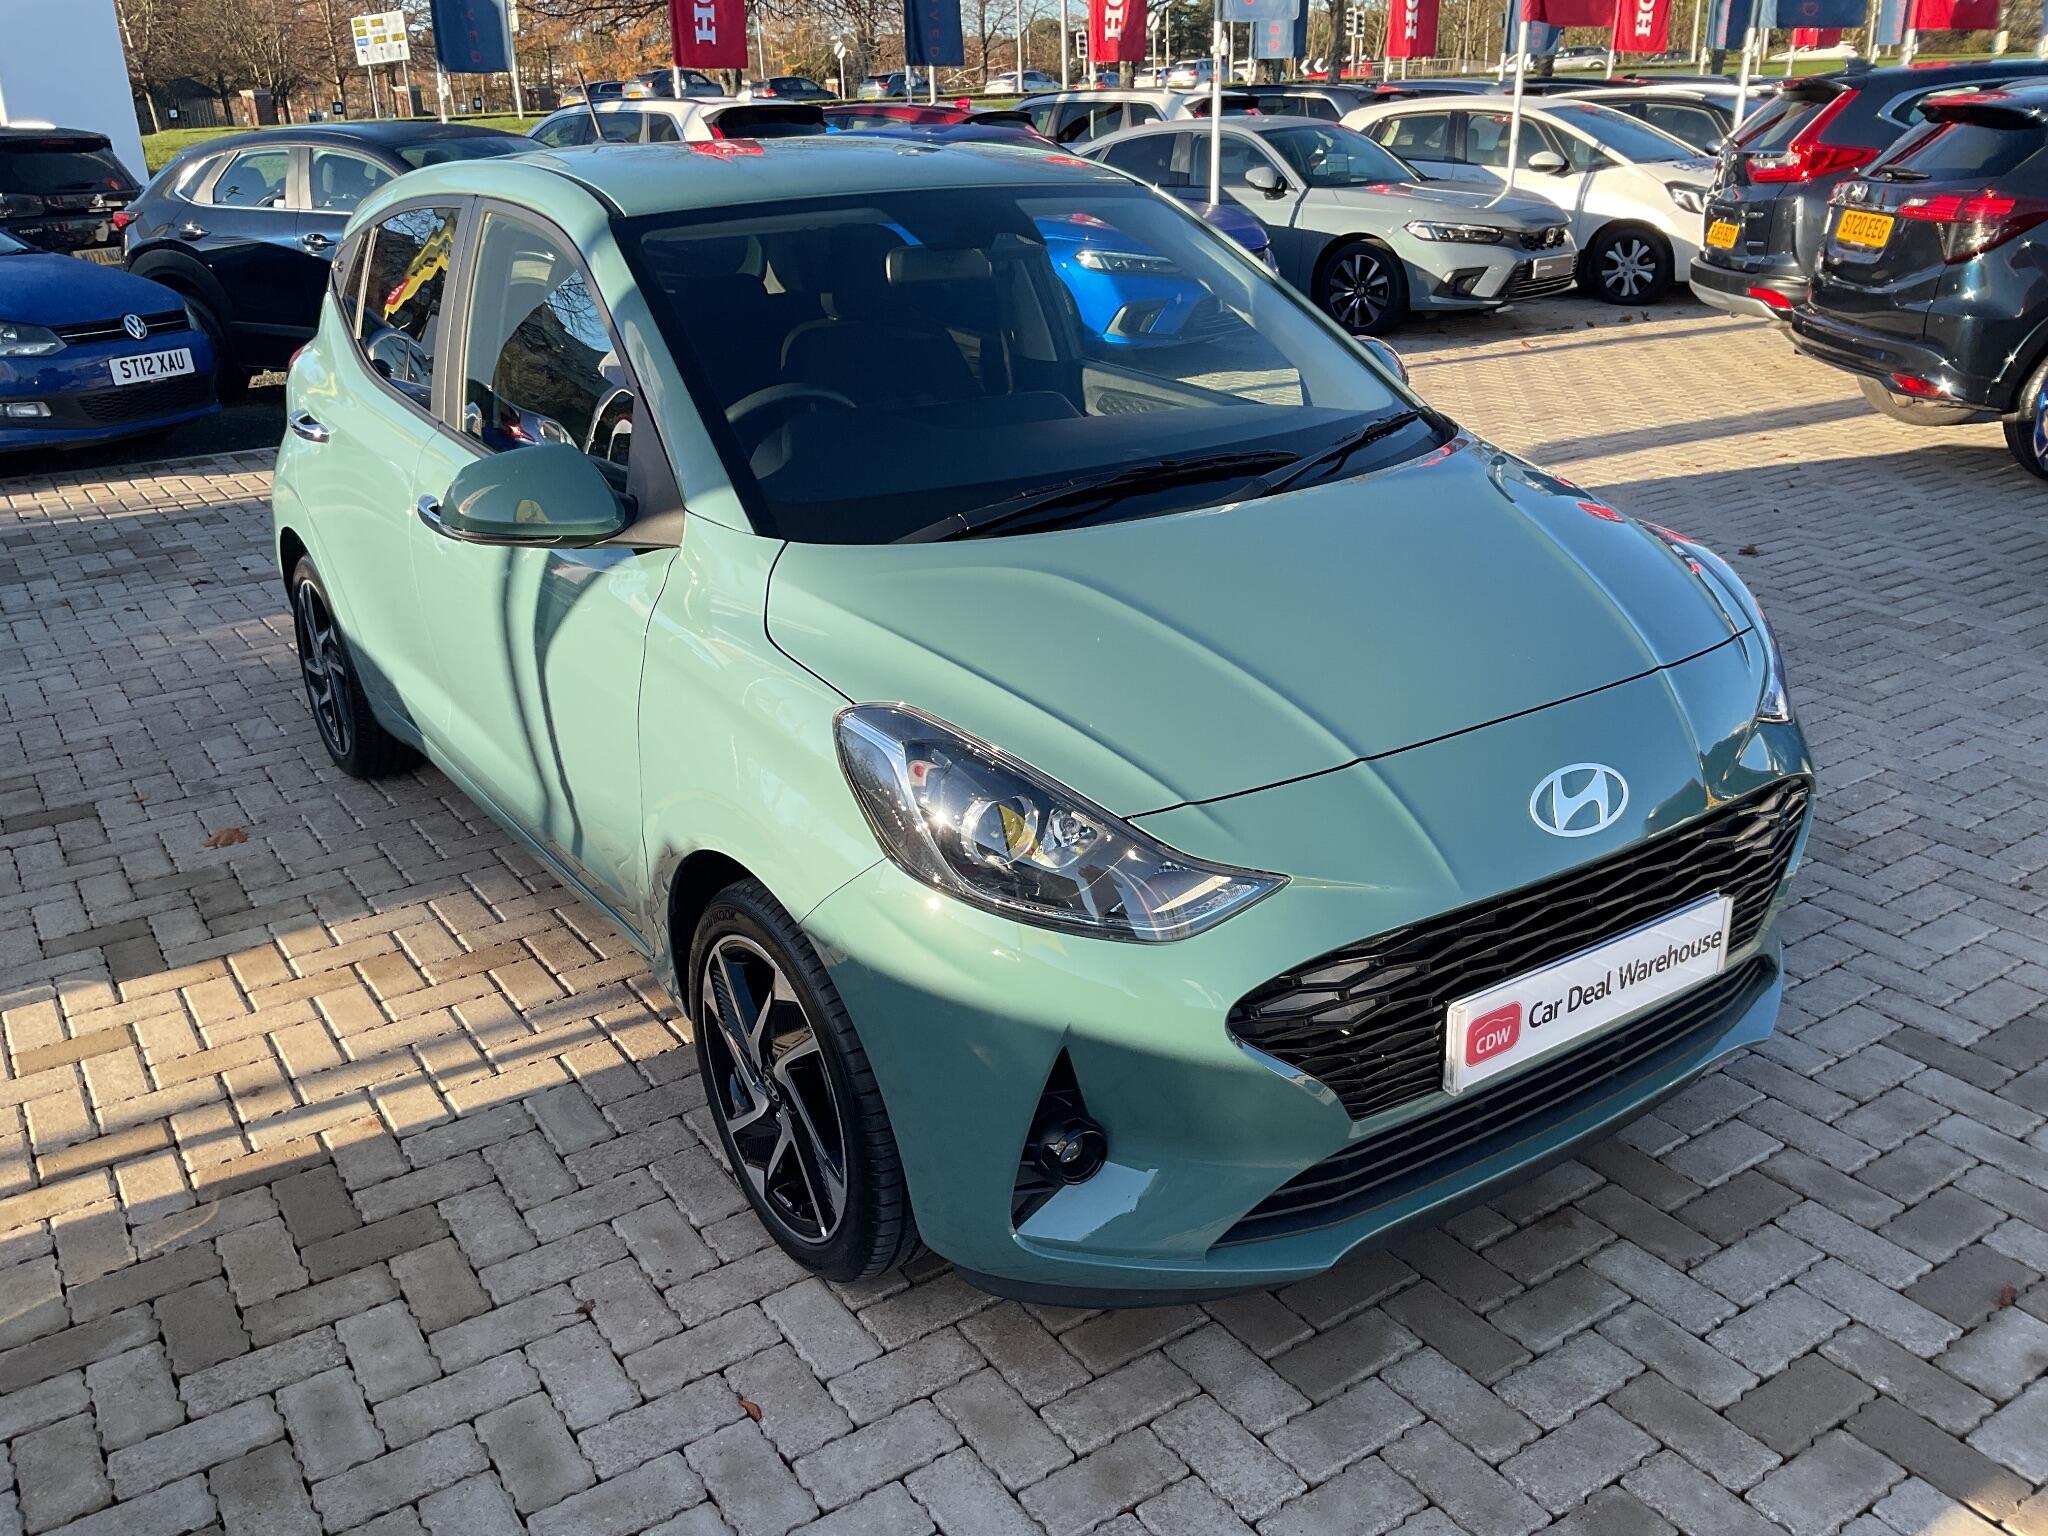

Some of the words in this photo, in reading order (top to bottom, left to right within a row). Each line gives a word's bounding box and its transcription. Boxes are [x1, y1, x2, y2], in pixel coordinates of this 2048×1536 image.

[119, 356, 156, 378] ST12
[157, 351, 185, 373] XAU
[1528, 999, 1563, 1028] Car
[1567, 970, 1612, 1013] Deal
[1618, 930, 1723, 990] Warehouse
[1476, 1026, 1512, 1055] CDW
